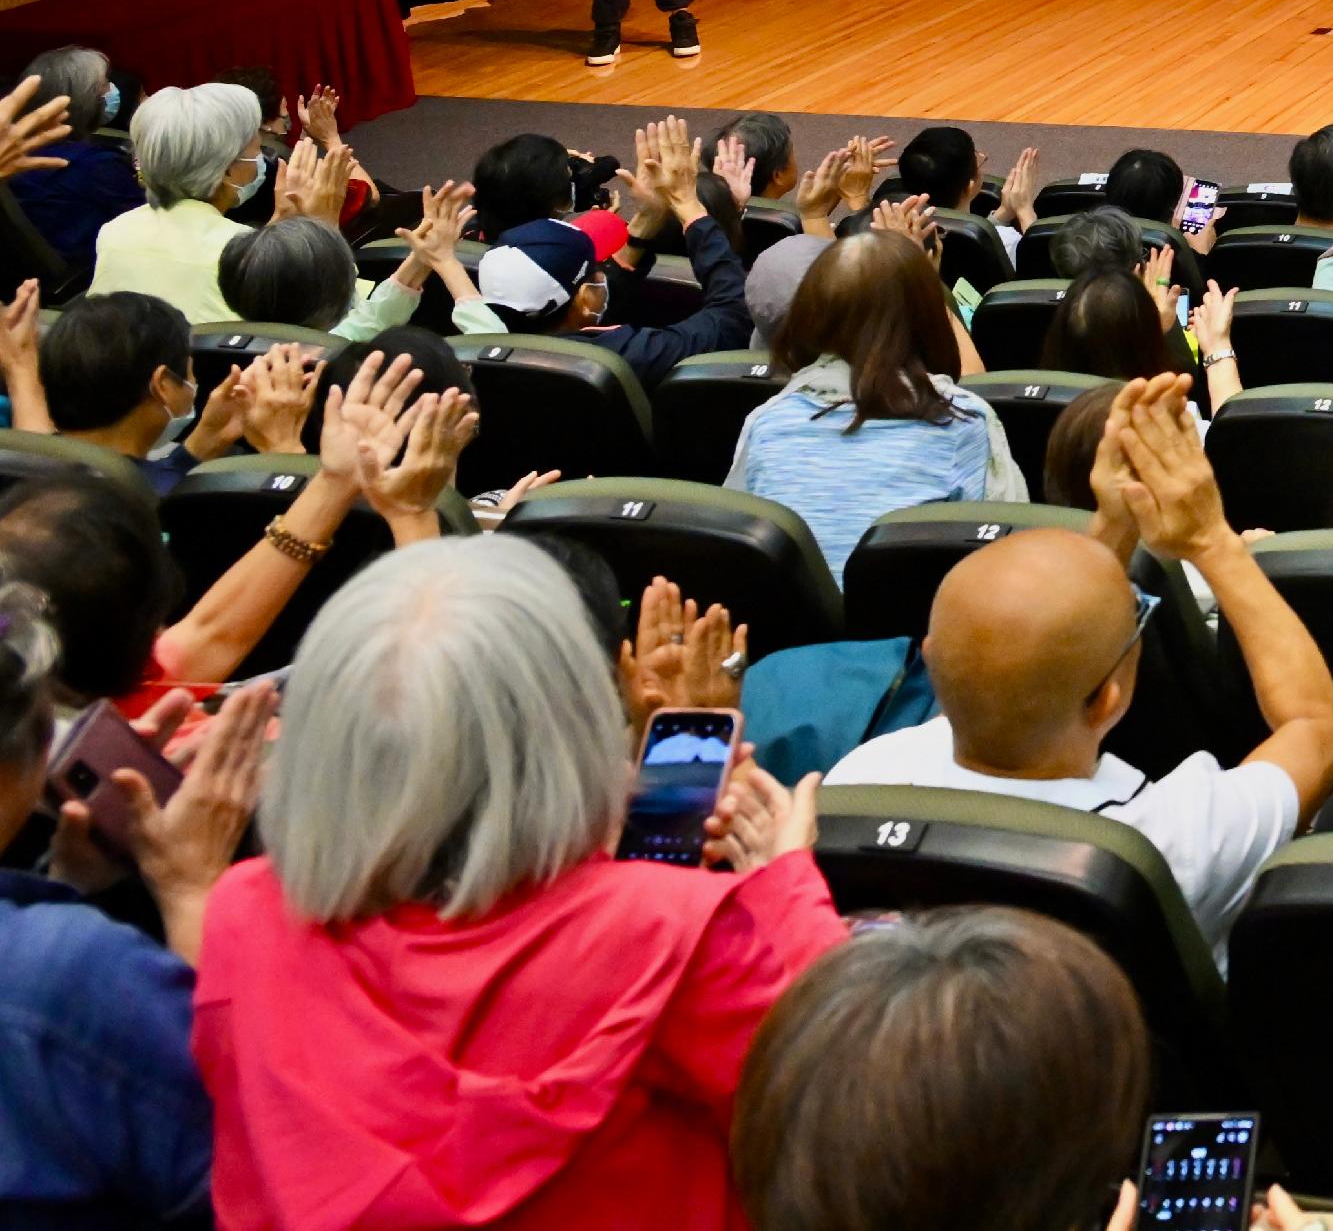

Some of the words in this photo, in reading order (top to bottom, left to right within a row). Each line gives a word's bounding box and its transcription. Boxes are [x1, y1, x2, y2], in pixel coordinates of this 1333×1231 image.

[1289, 302, 1301, 310] 11
[751, 365, 767, 375] 10
[1025, 386, 1039, 396] 11
[1315, 399, 1331, 410] 12
[273, 476, 294, 489] 10
[623, 502, 643, 516] 11
[978, 525, 999, 539] 12
[877, 821, 910, 846] 13
